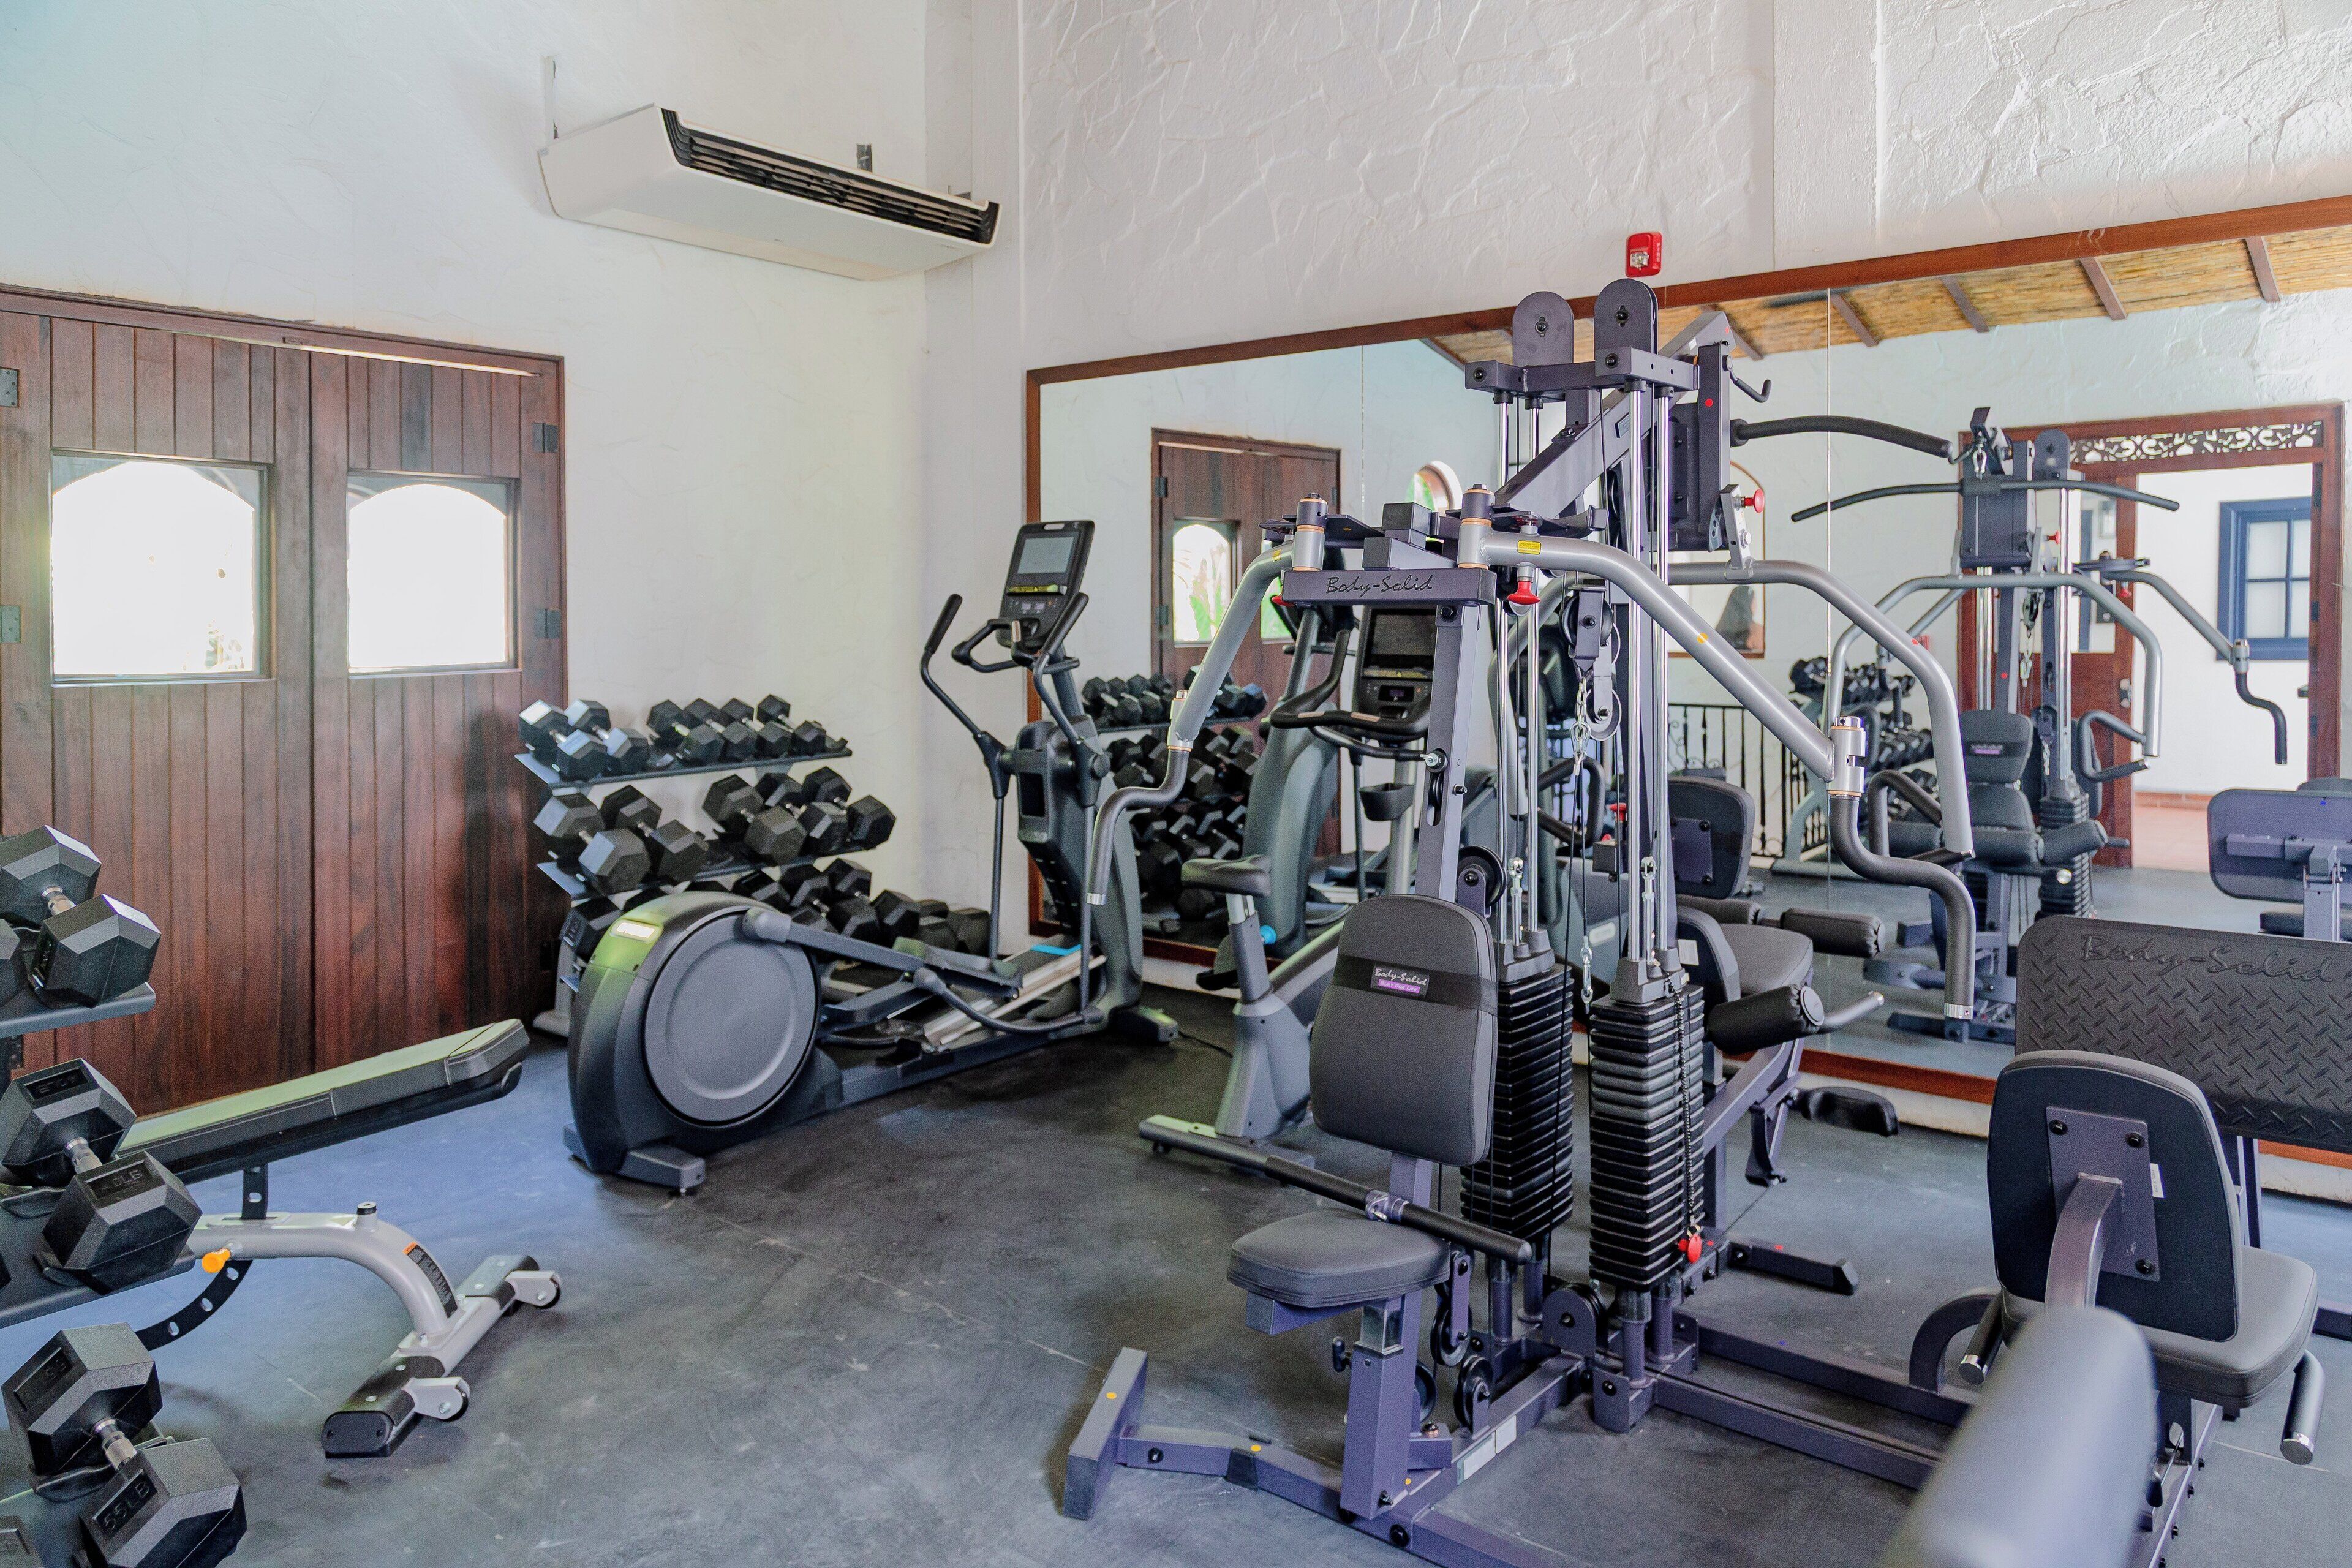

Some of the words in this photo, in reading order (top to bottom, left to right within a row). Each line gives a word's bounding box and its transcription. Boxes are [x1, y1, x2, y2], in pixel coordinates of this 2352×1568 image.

[1326, 574, 1433, 598] Body-Solid
[2081, 934, 2334, 982] Body-Solid
[1374, 968, 1427, 986] Body-Solid
[104, 1480, 151, 1529] 55LB
